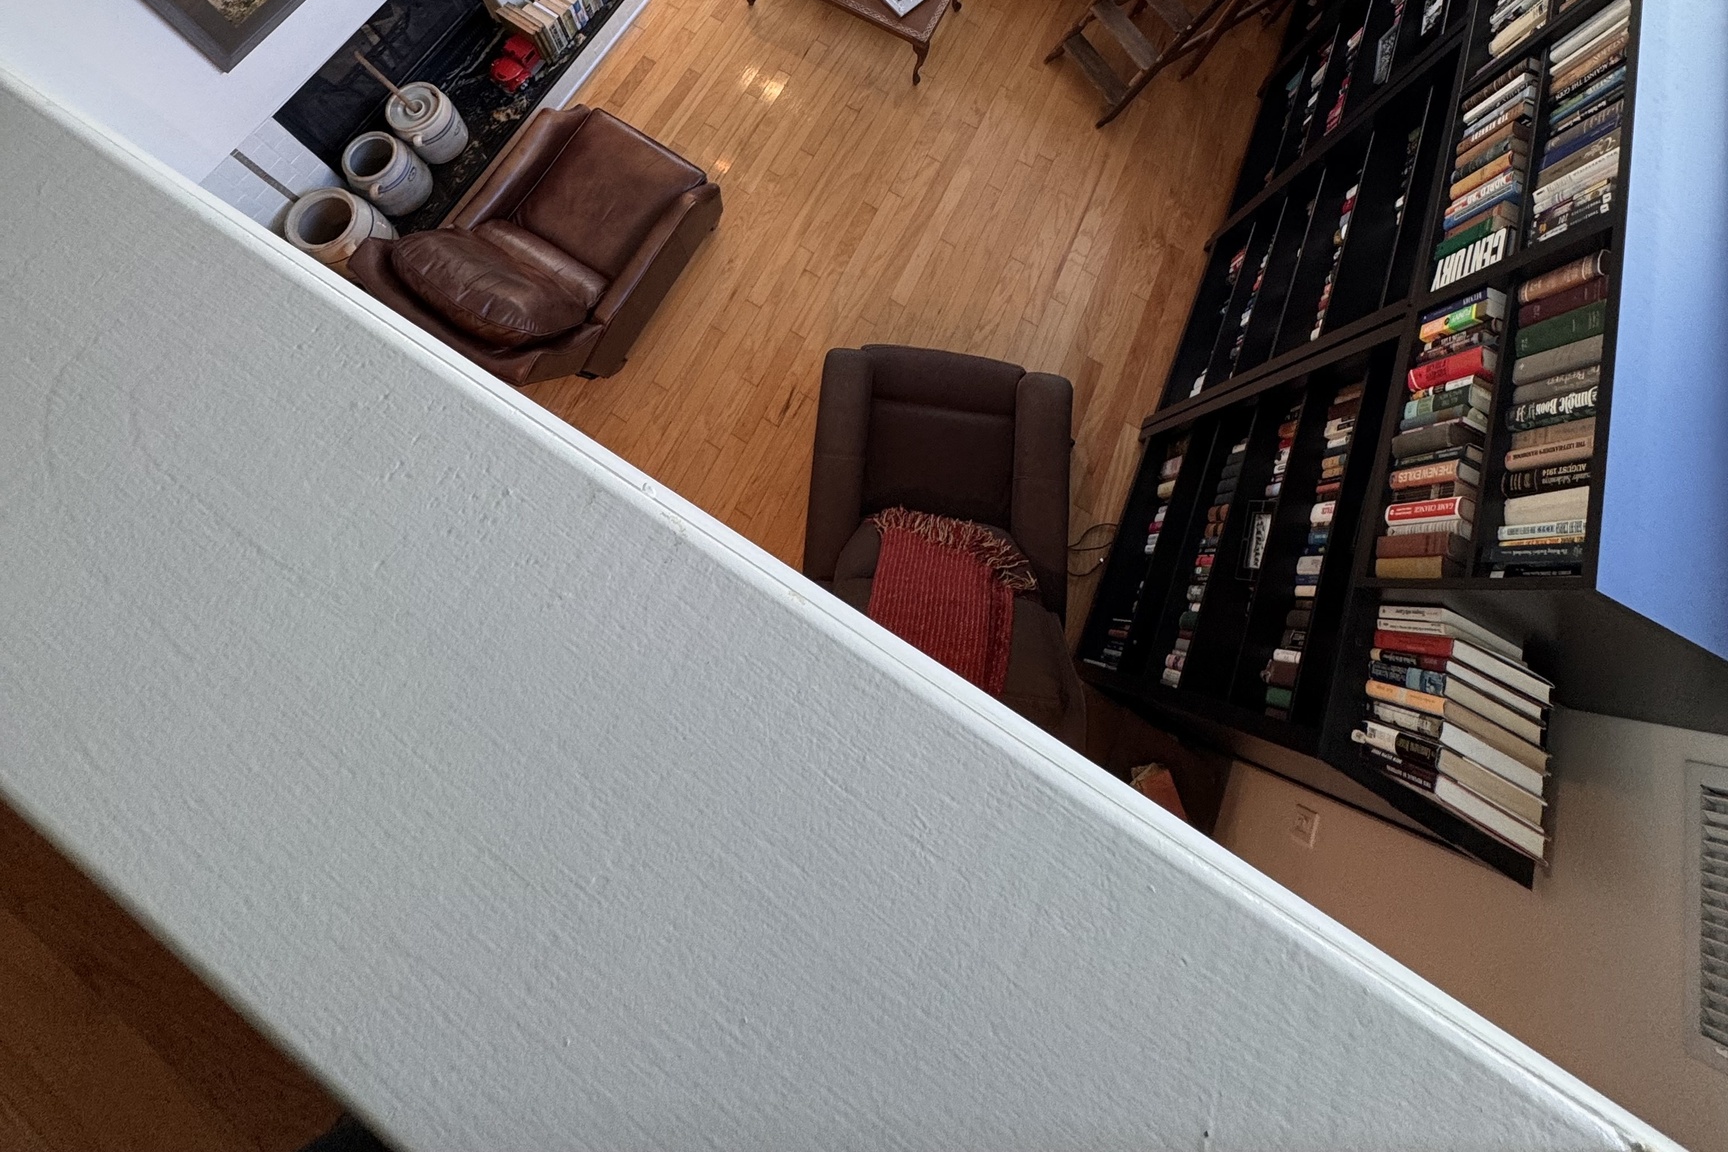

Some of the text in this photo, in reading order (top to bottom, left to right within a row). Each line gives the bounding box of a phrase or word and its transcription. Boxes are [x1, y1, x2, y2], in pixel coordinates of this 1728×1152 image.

[1583, 61, 1609, 79] AGAINST
[1429, 227, 1506, 291] CENTURY
[1558, 387, 1596, 413] Jungle
[1398, 463, 1453, 480] THE NEW EXILES
[1542, 462, 1586, 475] AUGUST 1914
[1414, 502, 1435, 513] CHANGE
[1437, 502, 1452, 511] GAME
